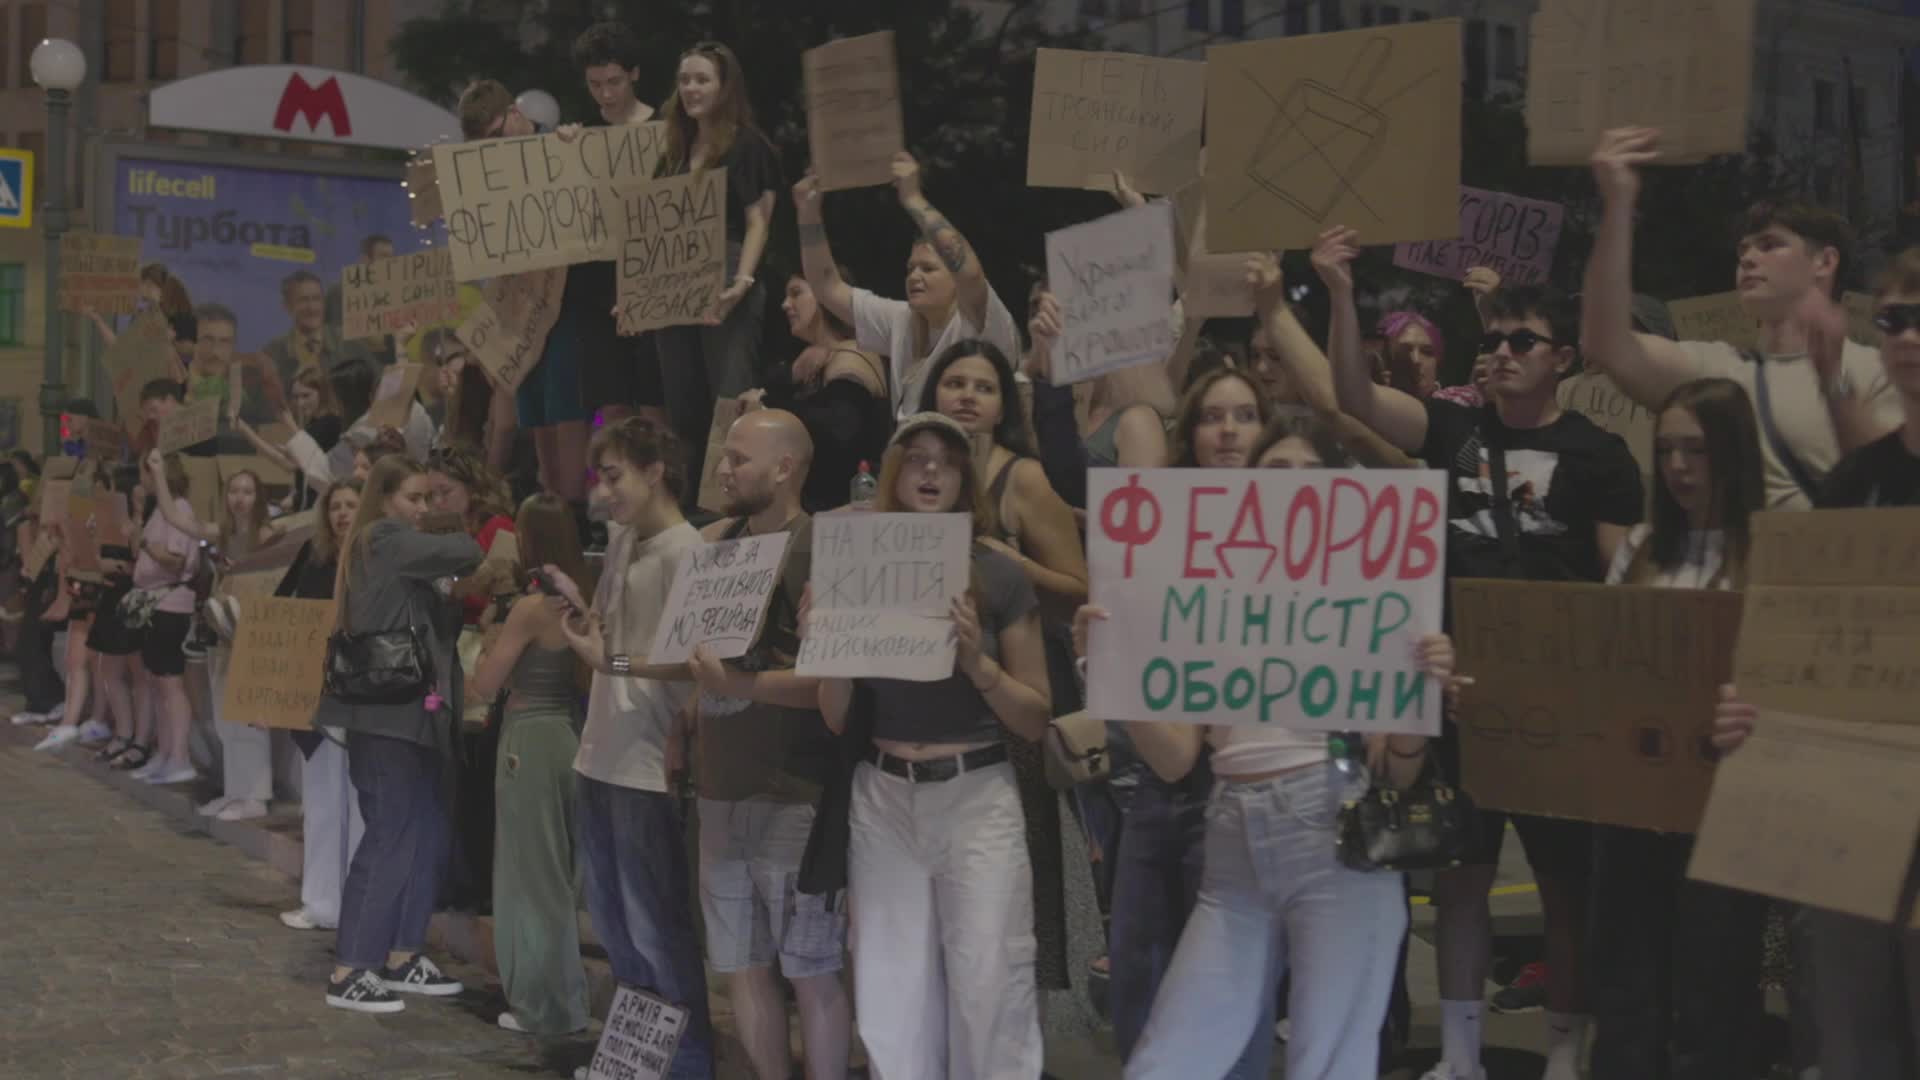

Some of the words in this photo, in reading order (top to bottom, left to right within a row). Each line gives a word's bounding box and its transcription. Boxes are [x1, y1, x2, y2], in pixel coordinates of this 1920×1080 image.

[128, 169, 217, 200] lifecell
[452, 134, 565, 196] ГЕТЬ
[127, 204, 312, 251] Турбота
[449, 184, 609, 260] ФЕДОРОВА
[624, 178, 719, 236] НАЗАД
[623, 229, 715, 279] БУЛАВУ
[818, 520, 855, 558] НА
[872, 519, 946, 557] КОНУ
[1100, 473, 1441, 586] ФЕДОРОВ
[816, 560, 945, 609] ЖИТТЯ
[617, 992, 662, 1025] АРМІЯ
